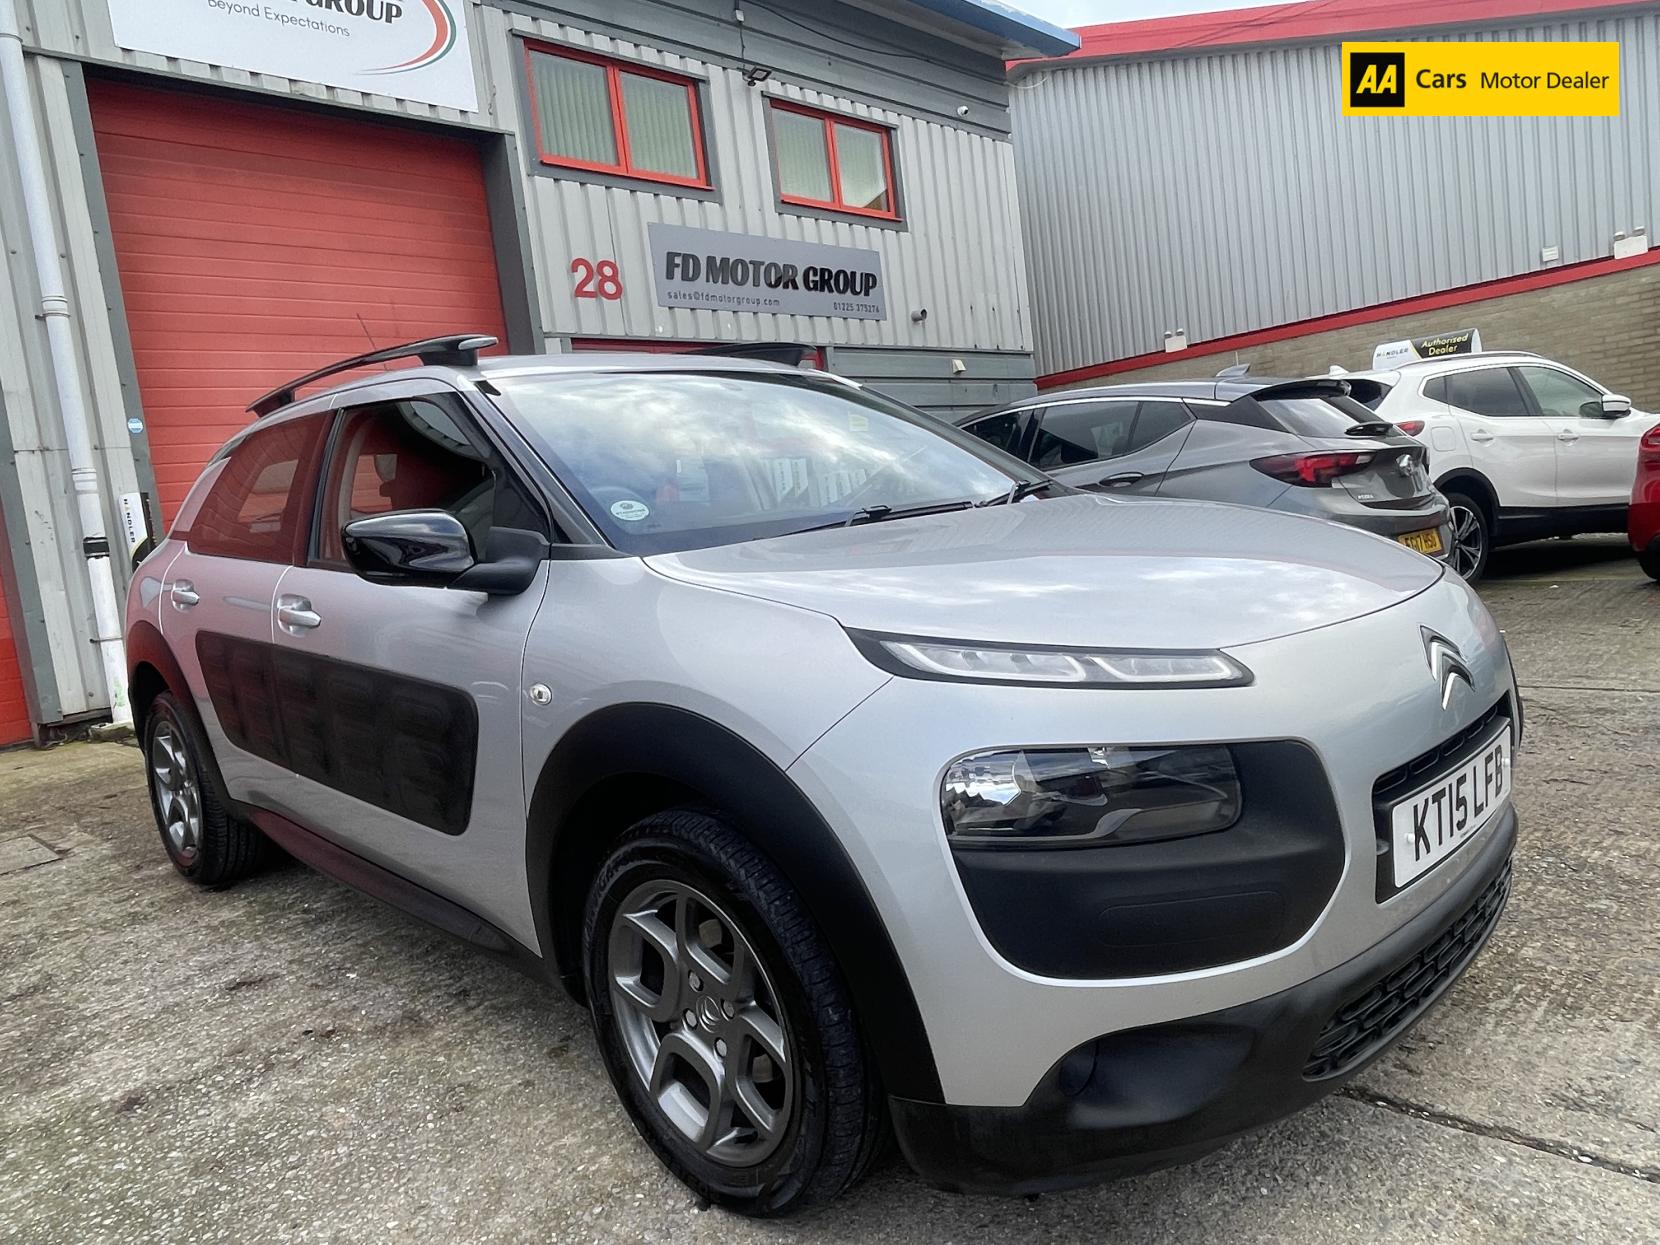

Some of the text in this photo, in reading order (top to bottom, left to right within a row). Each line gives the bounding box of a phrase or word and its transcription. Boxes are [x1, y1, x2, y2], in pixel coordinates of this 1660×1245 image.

[264, 6, 351, 37] Expectations
[571, 257, 623, 301] 28
[665, 251, 878, 297] FD MOTOR GROUP
[667, 290, 781, 307] sales@fdmotorgroup.com
[1420, 333, 1469, 348] Authorised
[1428, 345, 1458, 356] Dealer
[1413, 744, 1503, 862] KT15 LFB
